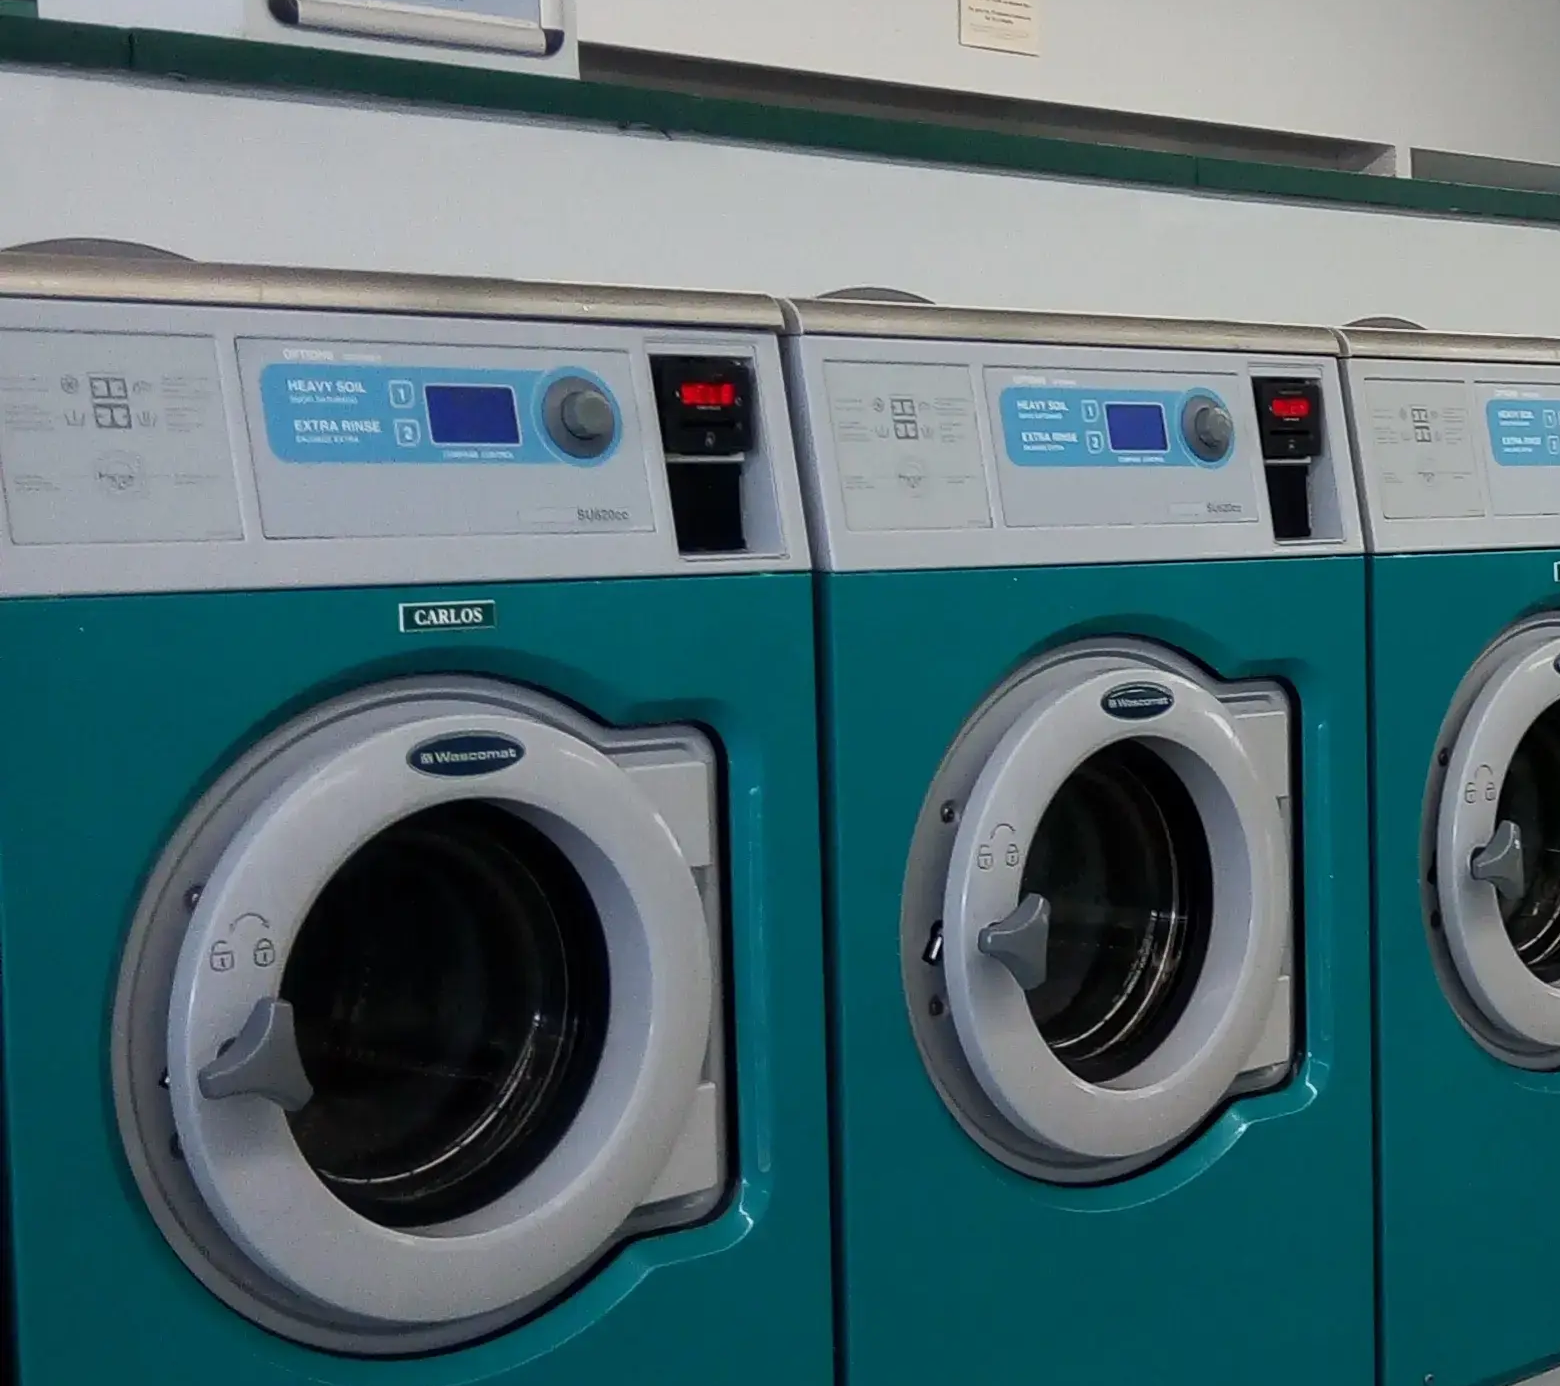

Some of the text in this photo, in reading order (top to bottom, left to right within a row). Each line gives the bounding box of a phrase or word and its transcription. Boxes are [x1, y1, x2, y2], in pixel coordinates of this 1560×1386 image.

[286, 379, 368, 394] HEAVY SOIL
[293, 419, 382, 434] EXTRA RINSE
[414, 607, 484, 626] CARLOS
[435, 747, 517, 764] Wascomat
